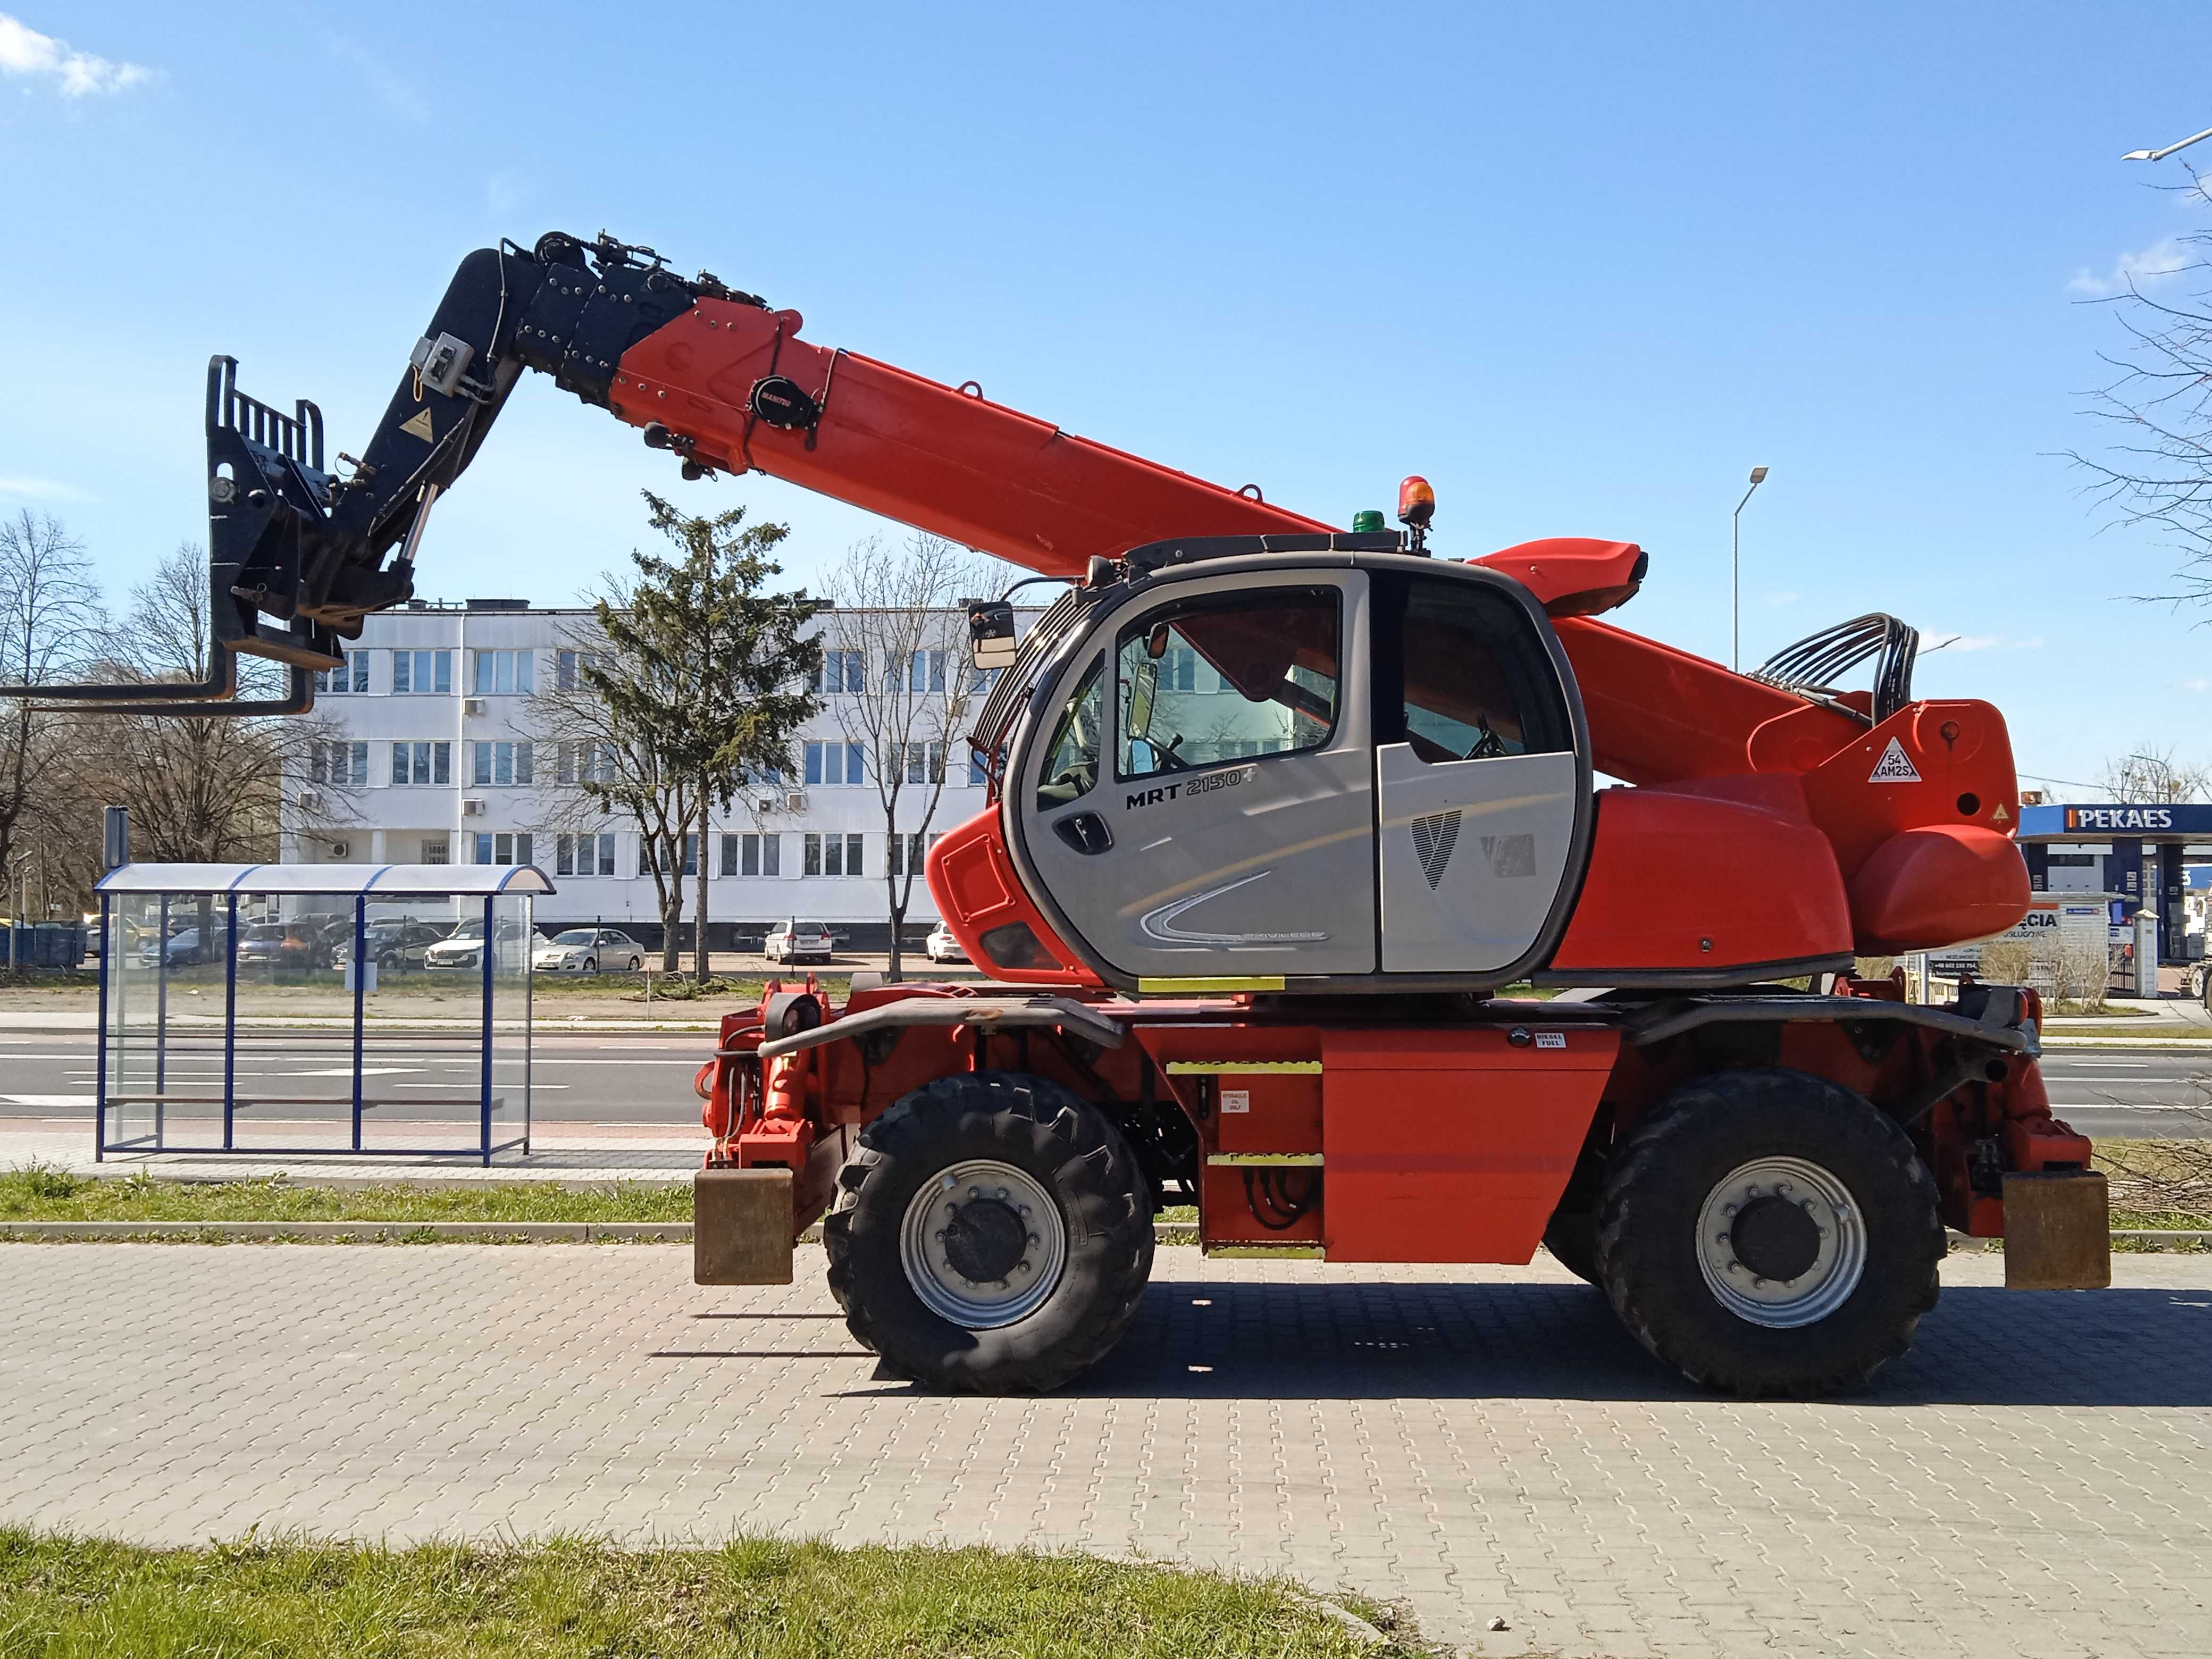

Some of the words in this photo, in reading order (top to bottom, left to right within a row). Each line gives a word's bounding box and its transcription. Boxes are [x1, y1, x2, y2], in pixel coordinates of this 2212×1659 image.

[761, 391, 792, 407] MANITOU
[1888, 755, 1901, 765] 54
[1881, 766, 1909, 776] AM2S
[1127, 783, 1182, 810] MRT
[2079, 809, 2172, 828] PEKAES
